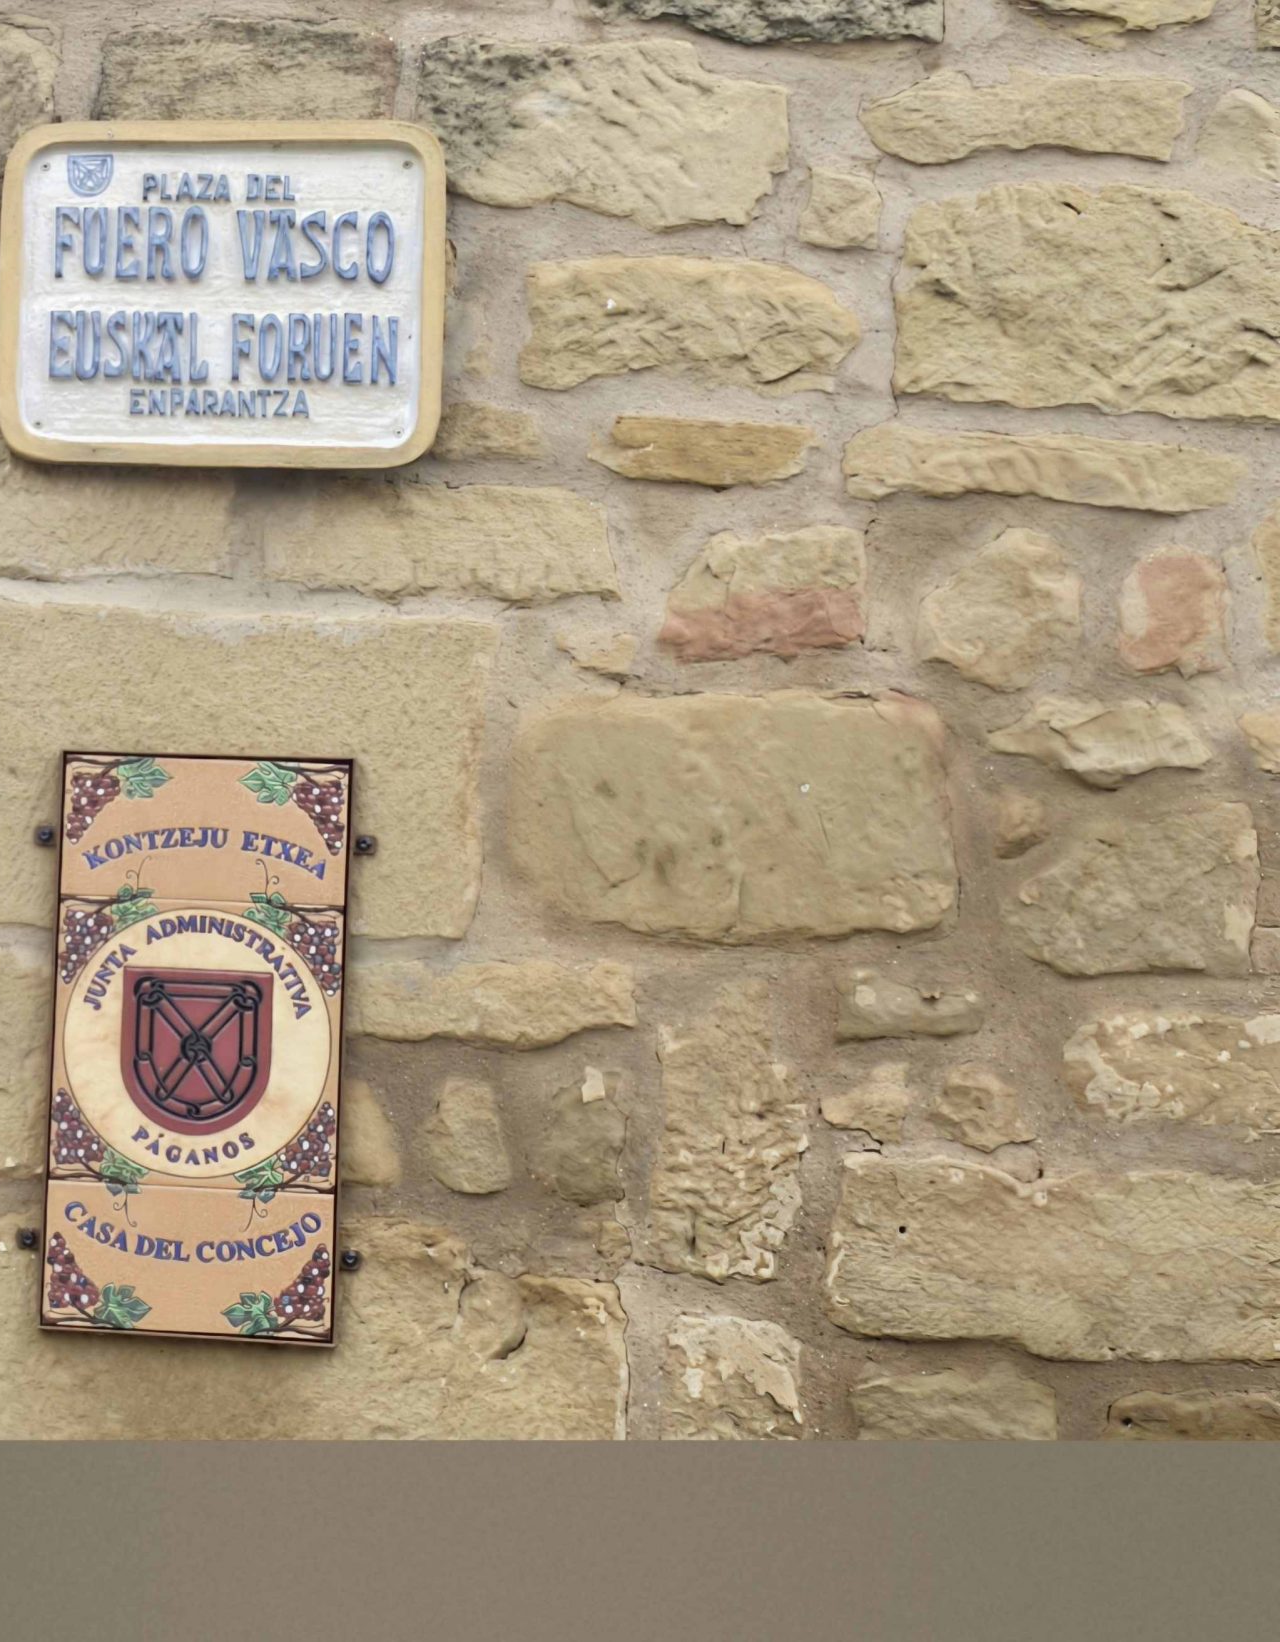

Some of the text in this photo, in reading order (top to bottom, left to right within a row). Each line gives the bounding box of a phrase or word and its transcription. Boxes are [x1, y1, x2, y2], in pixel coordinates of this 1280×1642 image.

[143, 172, 296, 202] PLAZA DEL
[55, 205, 395, 285] FUERO VASCO
[49, 309, 399, 386] EUSKAL FORUEN
[129, 388, 310, 419] ENPARANTZA
[82, 827, 326, 880] KONTZEJU ETXEA
[83, 914, 312, 1020] JUNTA ADMINISTRATIVA
[64, 1201, 322, 1263] CASA DEL CONCEJO
